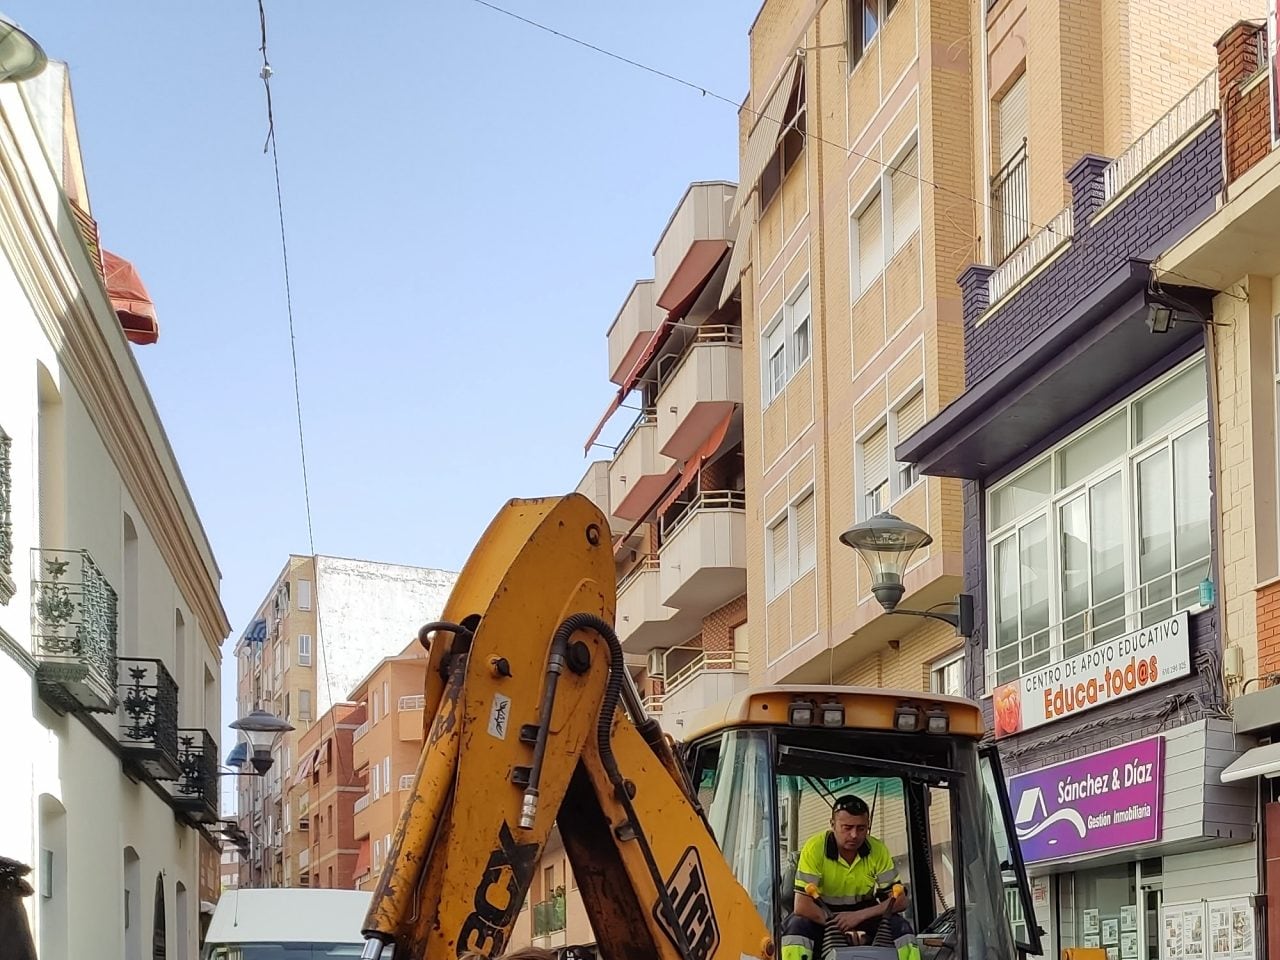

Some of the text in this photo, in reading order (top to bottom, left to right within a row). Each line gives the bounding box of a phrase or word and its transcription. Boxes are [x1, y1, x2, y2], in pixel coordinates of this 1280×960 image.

[1025, 619, 1180, 692] CENTRO DE APOYO EDUCATIVO
[1044, 655, 1159, 719] Educa-tod@s
[1057, 757, 1152, 803] Sánchez & Díaz
[1087, 803, 1151, 830] Gestión Inmobiliaria
[456, 818, 540, 959] 3CX
